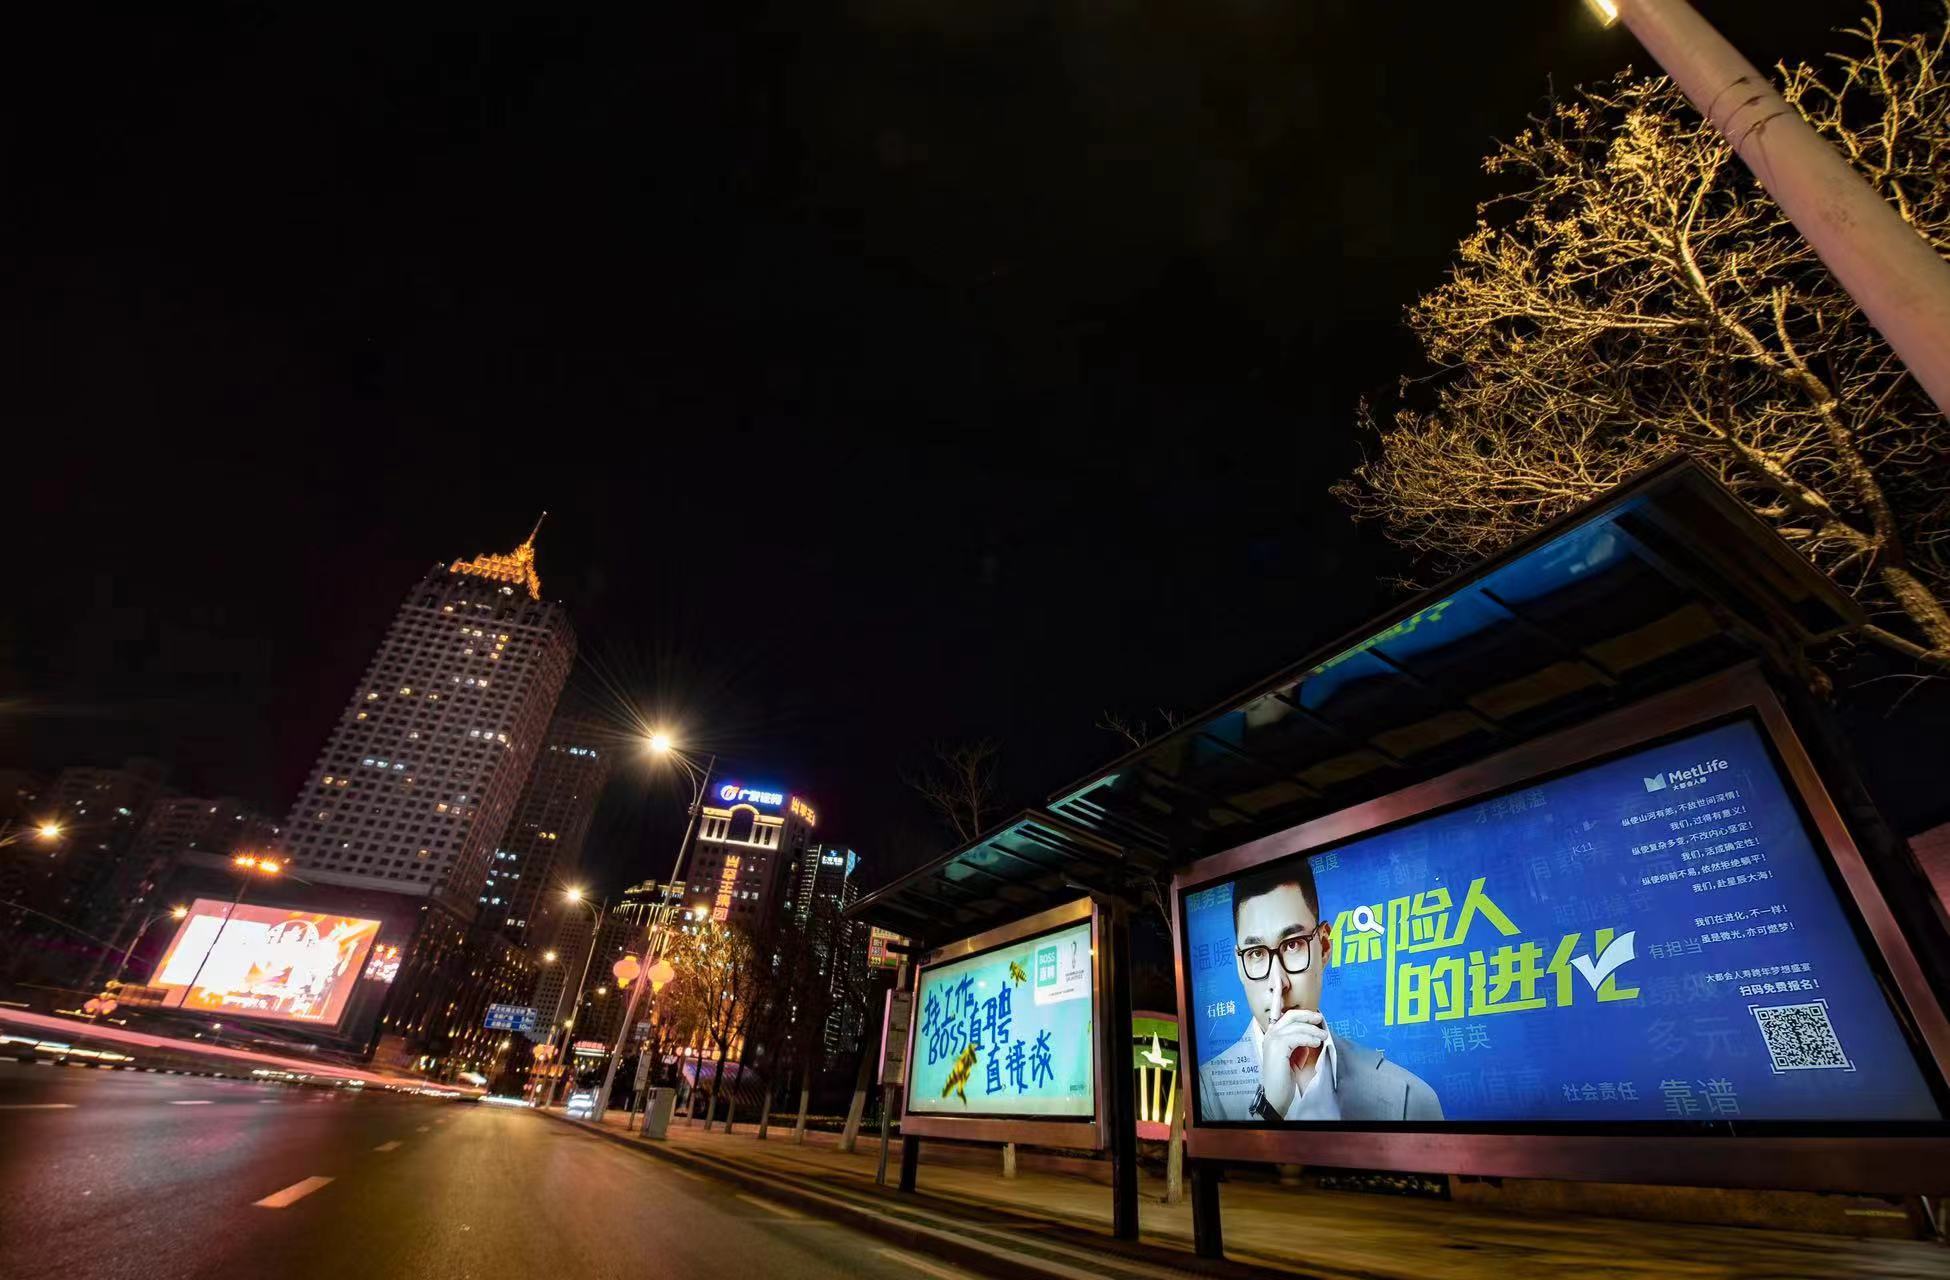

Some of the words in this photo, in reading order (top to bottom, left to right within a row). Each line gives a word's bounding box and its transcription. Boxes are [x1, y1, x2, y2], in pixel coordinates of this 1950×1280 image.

[1668, 758, 1729, 785] MetLife
[1670, 805, 1747, 831] 我们，过得有意义！
[1631, 821, 1753, 856] 纵使复杂多变，不改内心坚定！
[1681, 837, 1760, 862] 我们，活成确定性！
[1692, 870, 1774, 893] 我们，赴星辰大海！
[1694, 904, 1789, 928] 我们在进化，不一样！
[1701, 921, 1796, 944] 虽是微光，亦可燃梦！
[1193, 937, 1233, 971] 温暖
[1330, 876, 1522, 1026] 保险人
[1648, 938, 1703, 960] 有担当
[1397, 927, 1641, 1026] 的进化
[1738, 978, 1820, 998] 扫码免费报名！
[1327, 1017, 1369, 1040] 理心
[1441, 1023, 1492, 1052] 精英
[985, 1029, 1054, 1095] 直接谈
[1561, 1081, 1640, 1103] 社会责任
[1658, 1078, 1741, 1116] 靠谱
